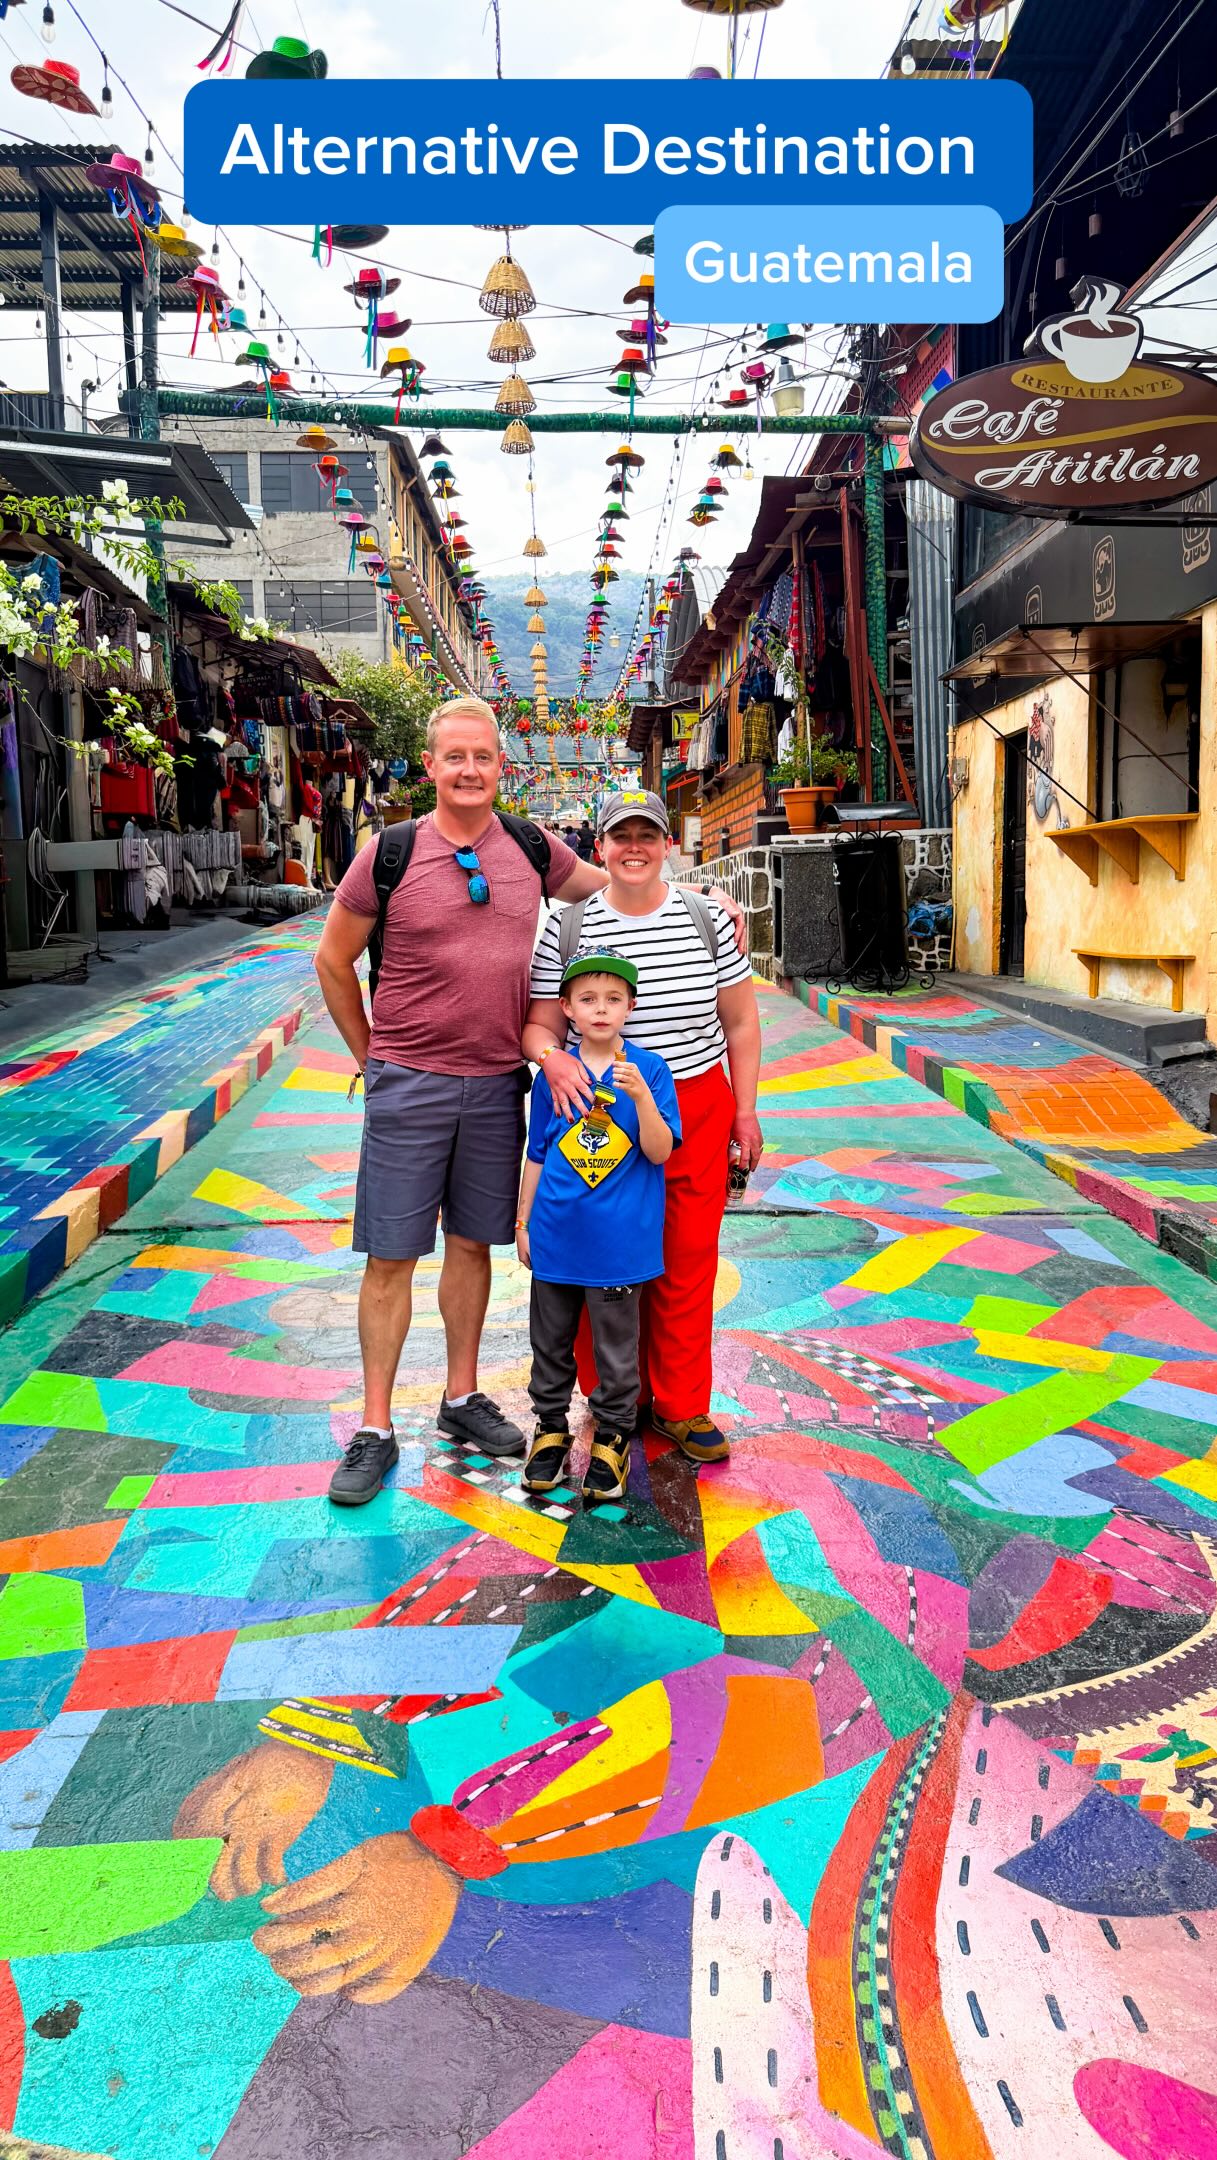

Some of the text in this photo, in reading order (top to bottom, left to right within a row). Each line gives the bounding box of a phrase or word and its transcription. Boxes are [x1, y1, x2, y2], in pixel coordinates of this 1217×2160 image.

[1021, 373, 1174, 399] RESTAURANTE
[928, 397, 1065, 445] Café
[974, 443, 1202, 491] Atitlán
[622, 791, 648, 805] M
[570, 1158, 618, 1168] CUB SCOUTS
